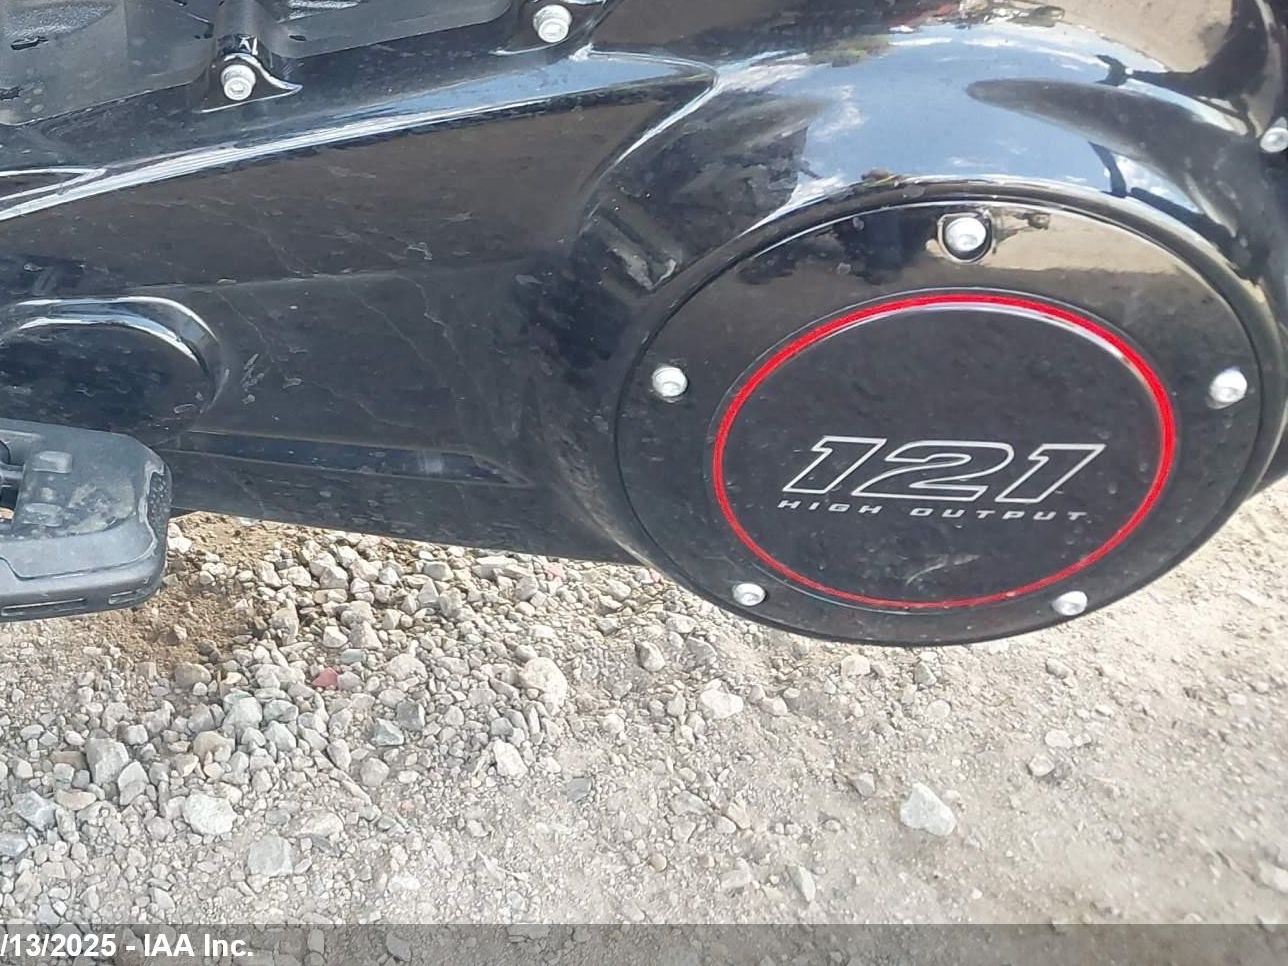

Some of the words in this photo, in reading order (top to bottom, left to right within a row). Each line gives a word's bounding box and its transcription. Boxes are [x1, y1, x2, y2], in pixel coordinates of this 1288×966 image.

[782, 435, 1106, 503] 121
[777, 500, 883, 514] HIGH
[910, 508, 1086, 521] OUTPUT
